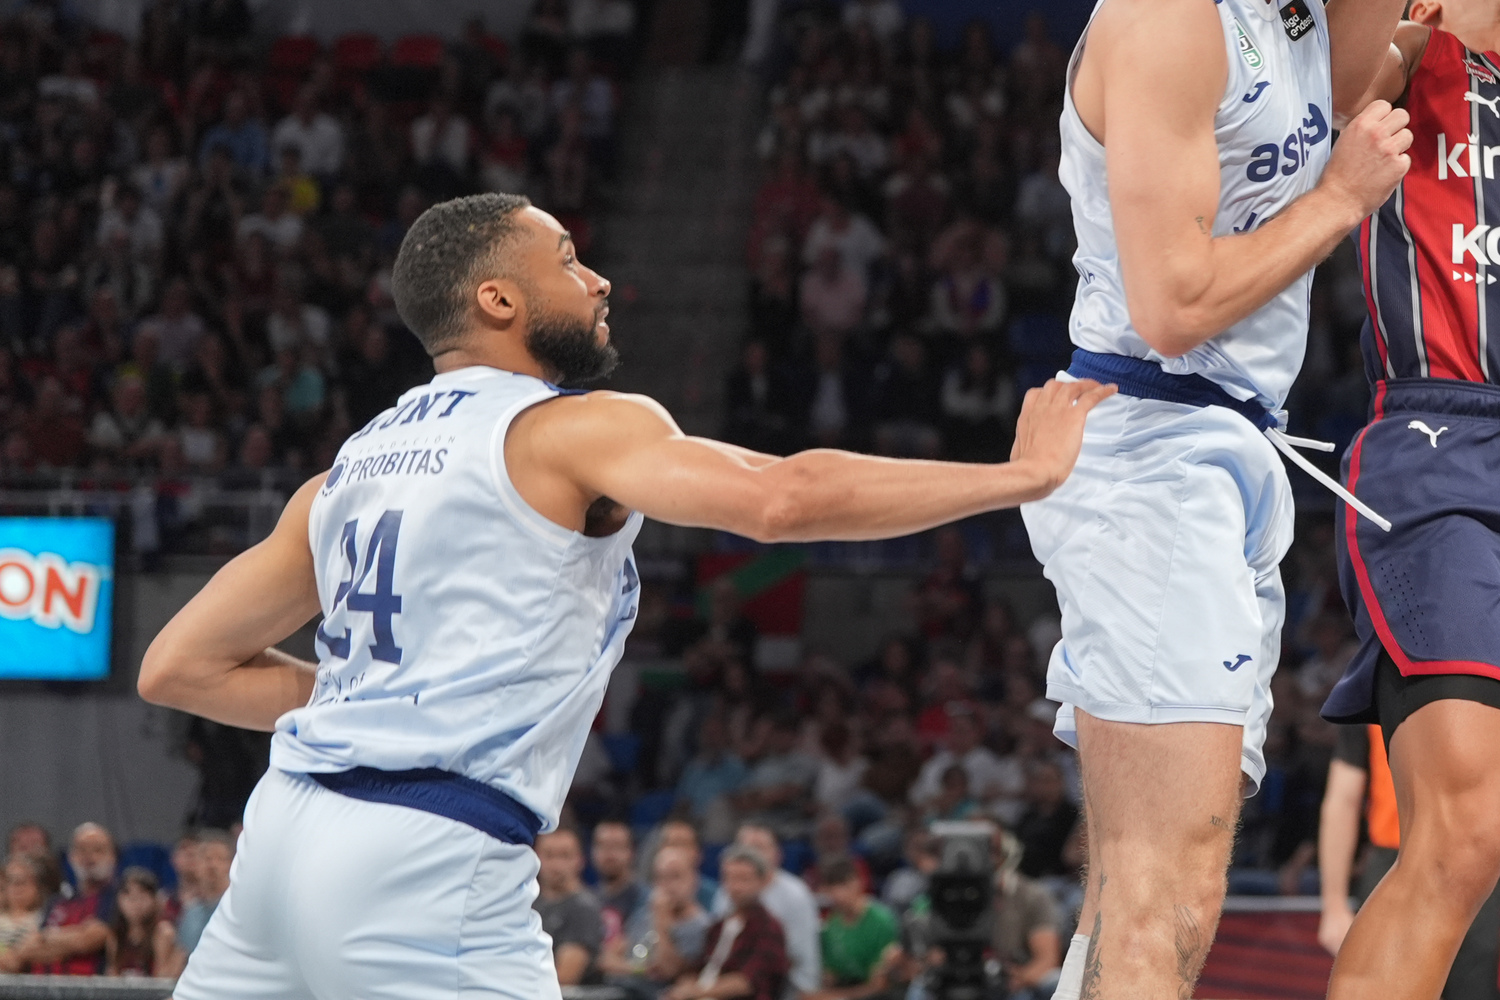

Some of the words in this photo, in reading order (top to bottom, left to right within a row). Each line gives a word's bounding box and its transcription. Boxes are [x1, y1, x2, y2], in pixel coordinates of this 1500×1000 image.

[1290, 14, 1313, 37] endesa
[346, 447, 449, 486] PROBITAS
[315, 509, 404, 666] 24
